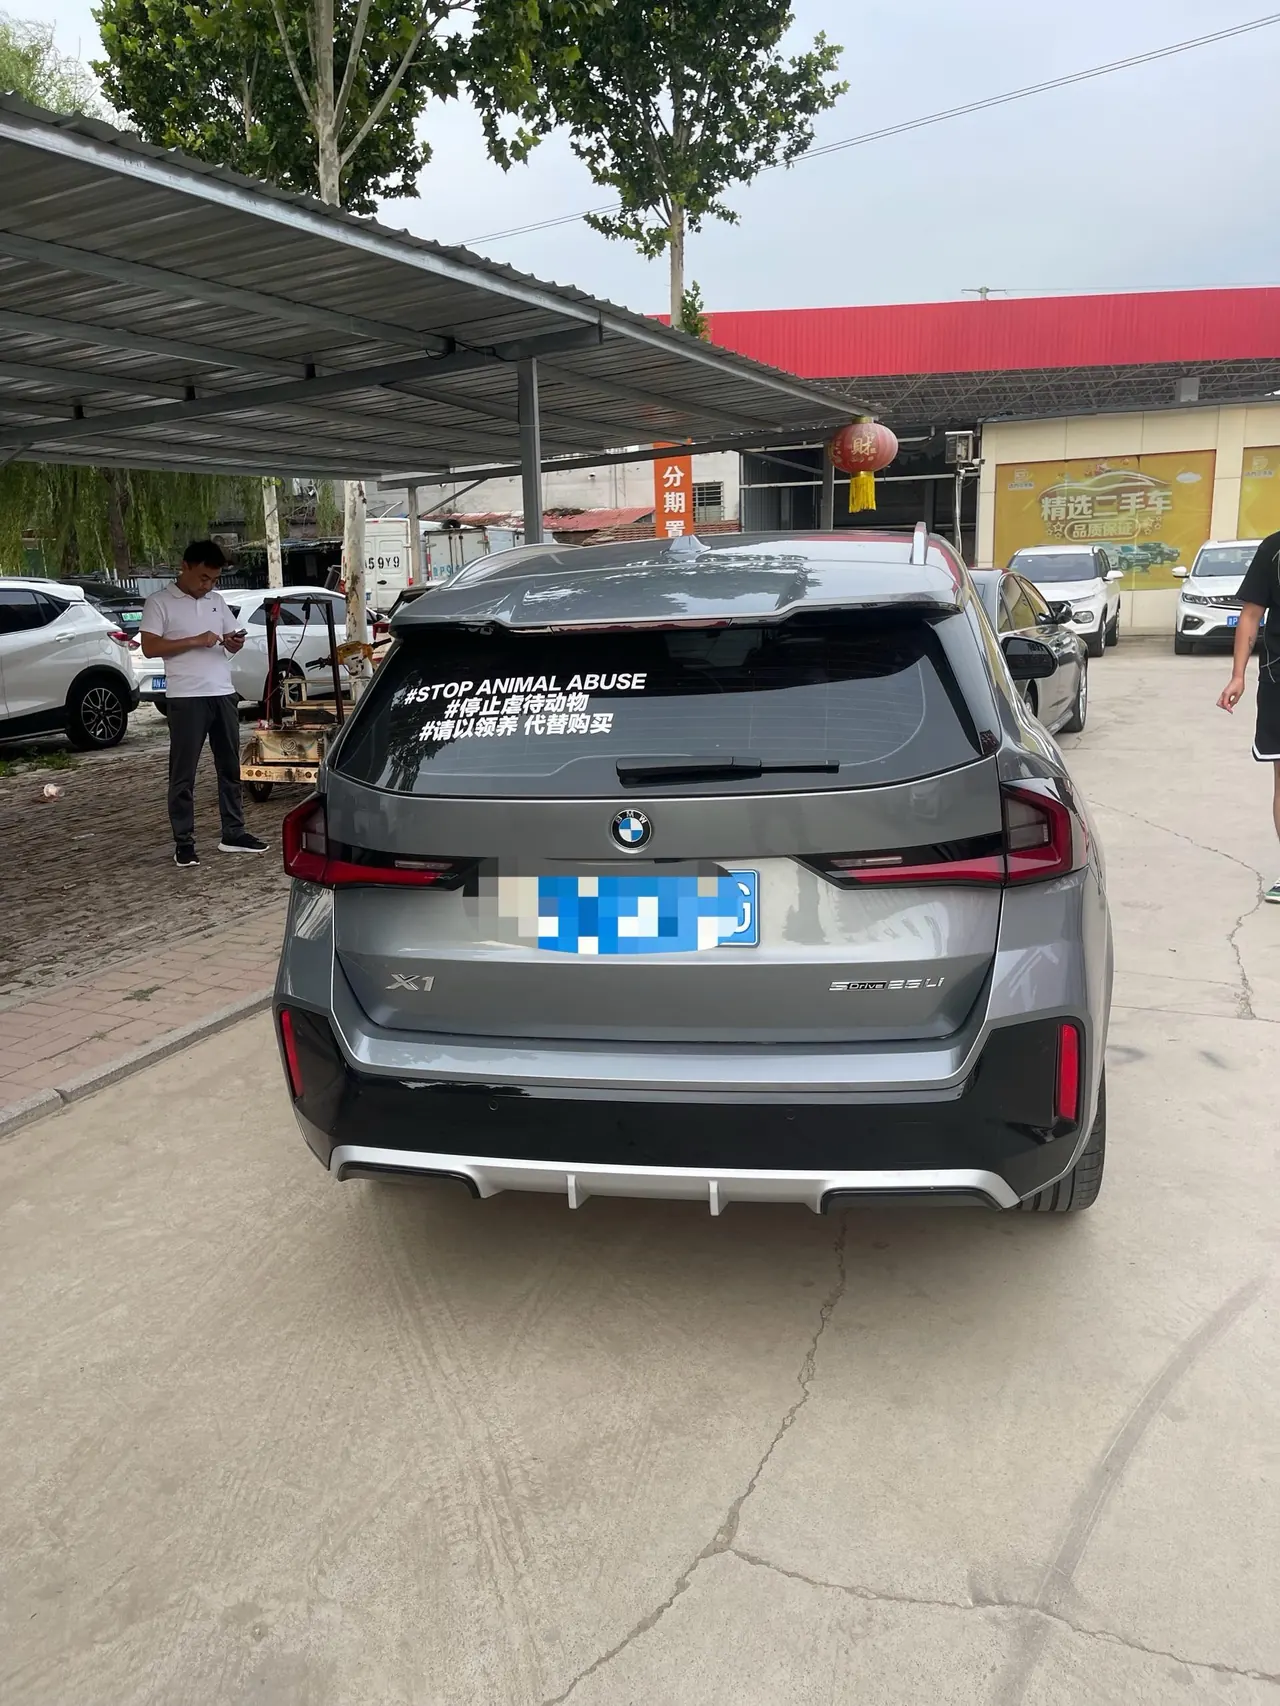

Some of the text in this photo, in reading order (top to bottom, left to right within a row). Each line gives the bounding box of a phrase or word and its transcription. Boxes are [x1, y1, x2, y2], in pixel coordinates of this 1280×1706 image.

[1040, 489, 1173, 522] 精选二手车
[1072, 522, 1134, 538] 品质保证
[404, 673, 648, 706] #STOP ANIMAL ABUSE
[443, 692, 589, 719] #停止虐待动物
[419, 712, 614, 742] #请以领养 代替购买
[384, 973, 436, 992] X1
